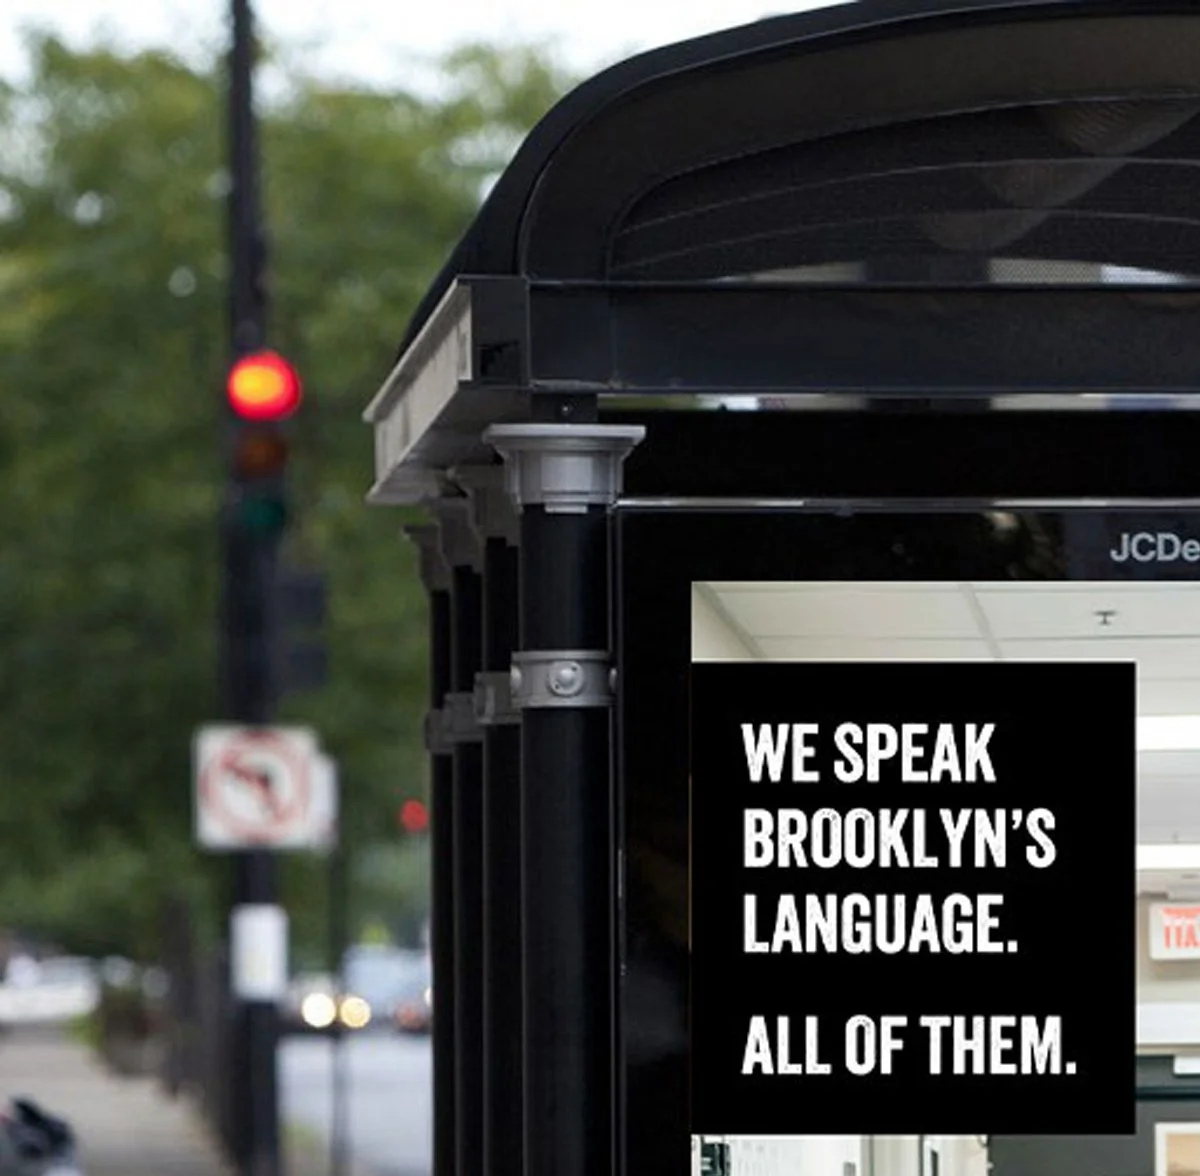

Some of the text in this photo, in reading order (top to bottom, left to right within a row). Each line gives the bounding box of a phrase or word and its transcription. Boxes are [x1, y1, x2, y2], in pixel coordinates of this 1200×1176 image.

[740, 721, 997, 783] WE SPEAK
[743, 807, 1057, 869] BROOKLYN’S
[743, 892, 1018, 954] LANGUAGE.
[741, 1014, 1077, 1076] ALL OF THEM.
